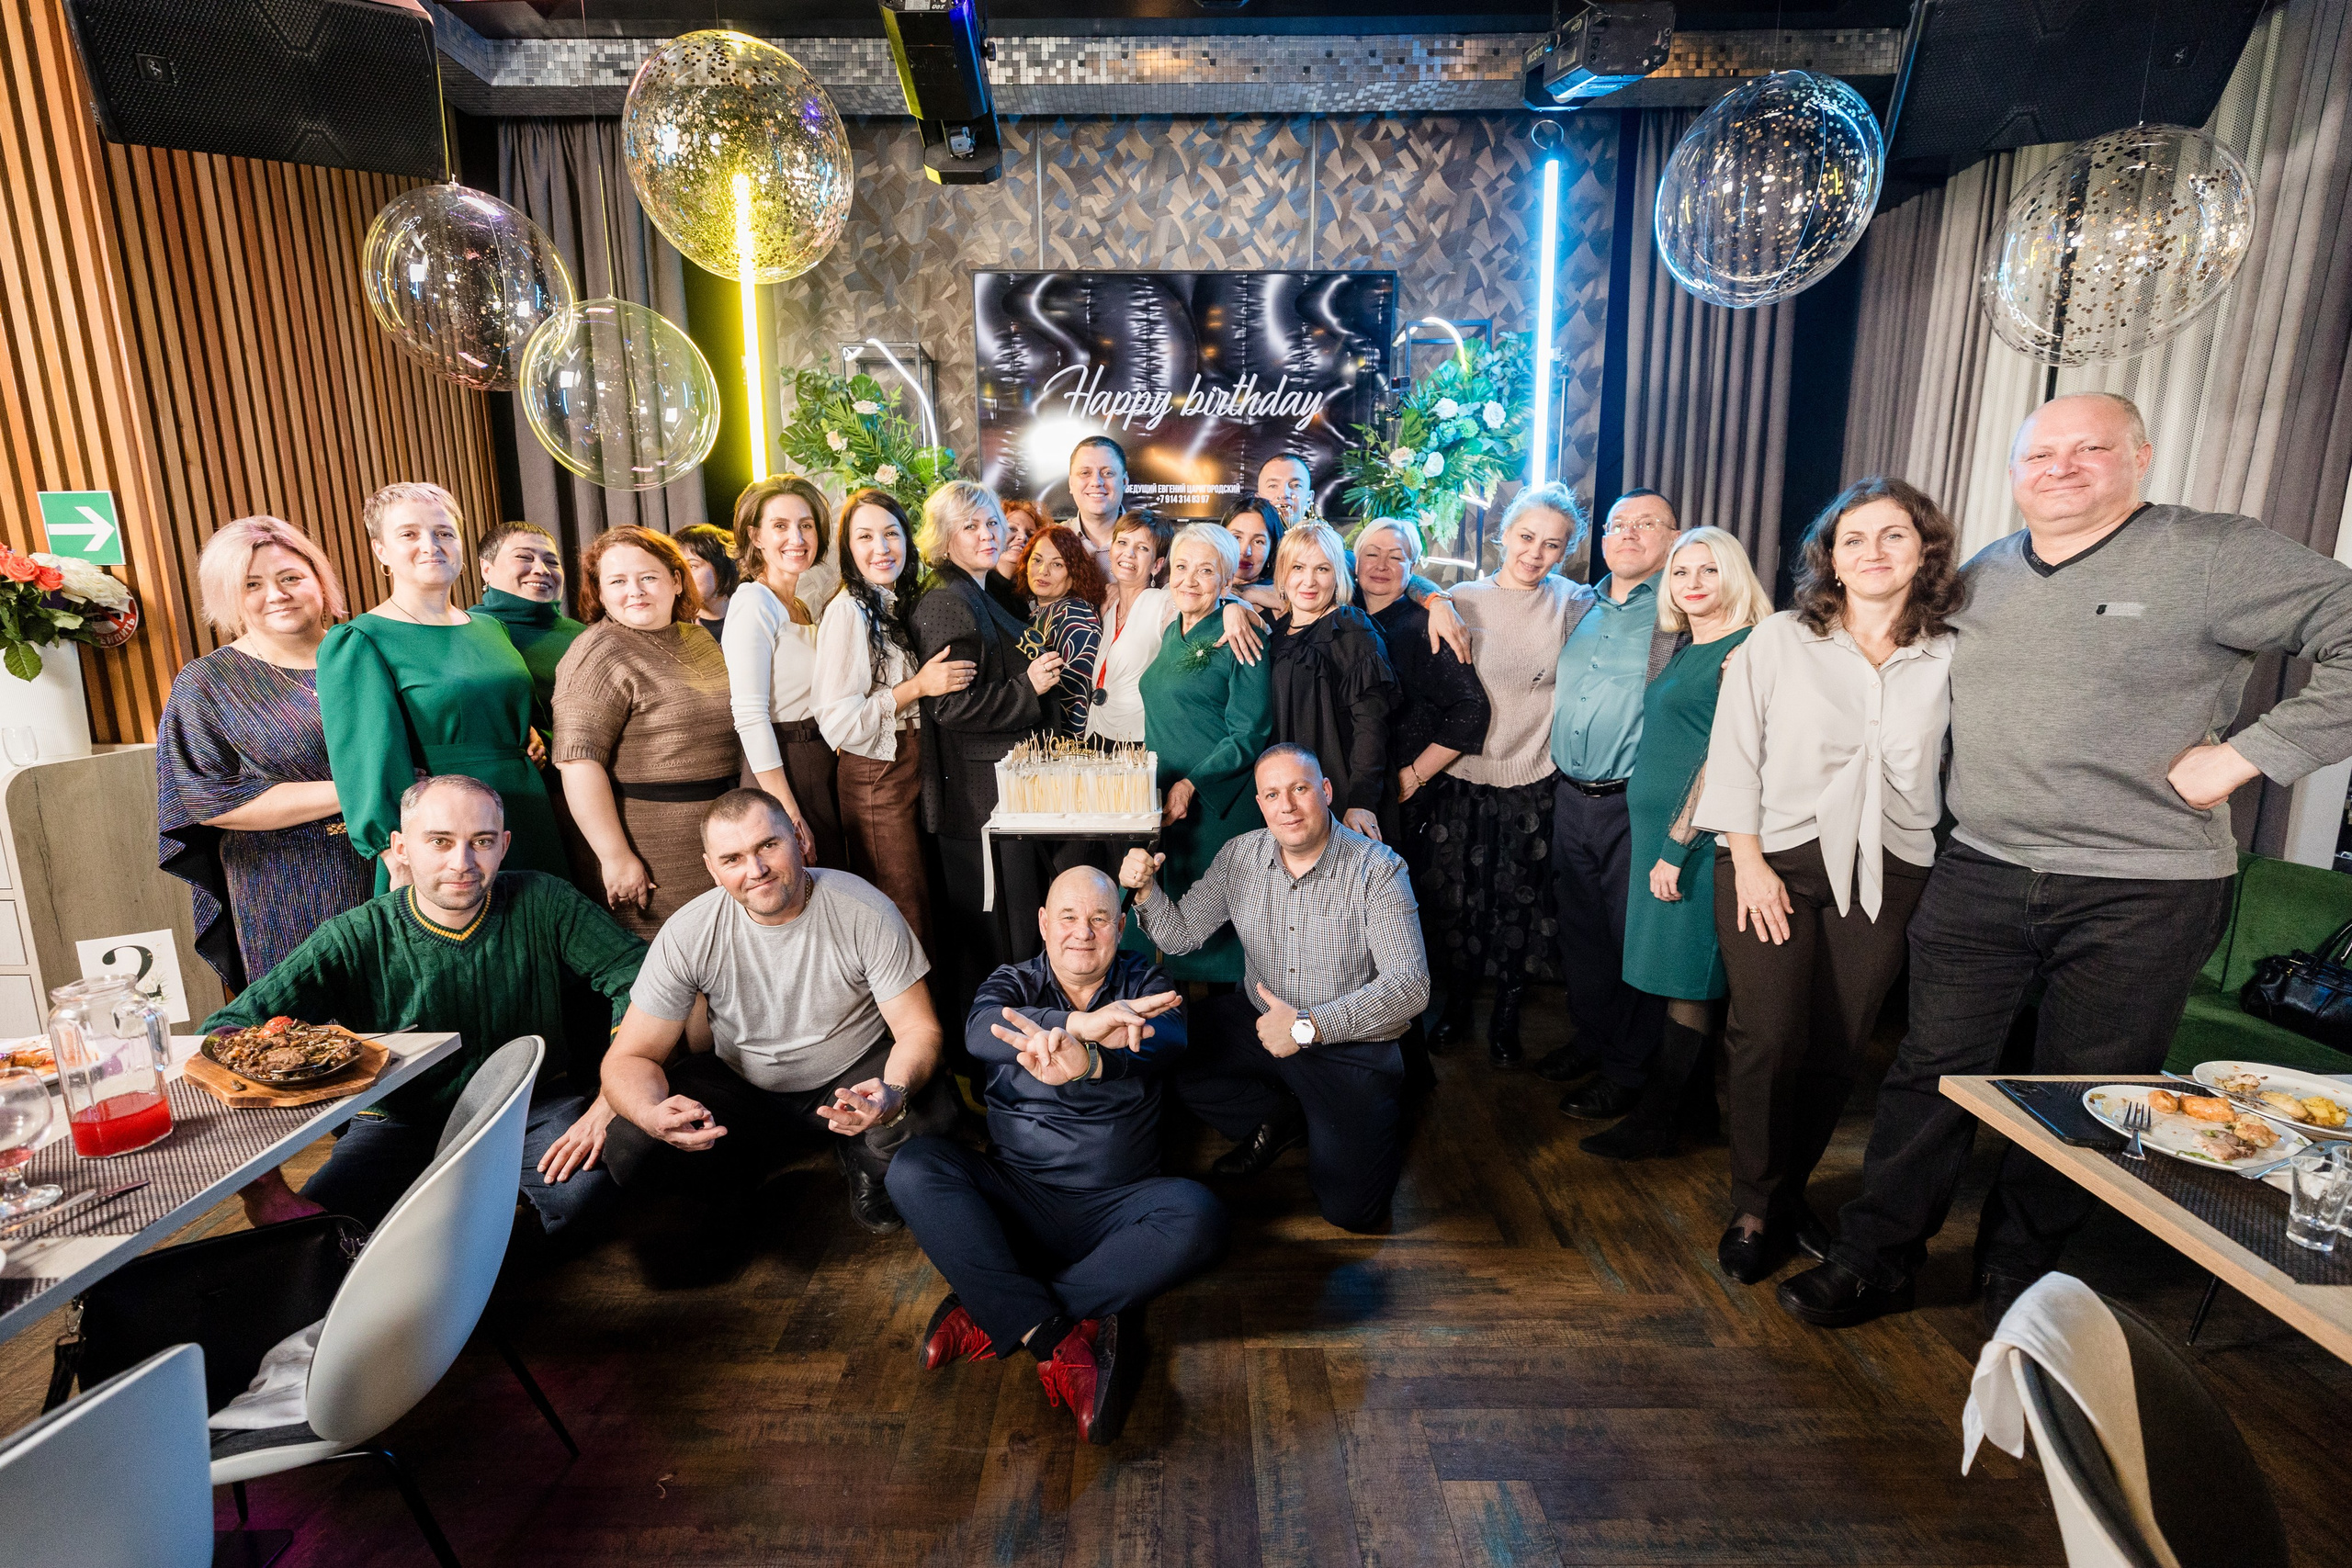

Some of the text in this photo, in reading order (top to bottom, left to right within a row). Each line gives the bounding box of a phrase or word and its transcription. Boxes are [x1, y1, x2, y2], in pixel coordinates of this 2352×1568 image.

[1043, 364, 1324, 432] Happy birthday
[1125, 482, 1241, 495] ВЕДУЩИЙ ЕВГЕНИЙ ЦАРИГОРОДСКИЙ
[1155, 494, 1210, 503] +7 914 314 83 97
[1015, 626, 1046, 660] 50
[102, 945, 163, 998] 2
